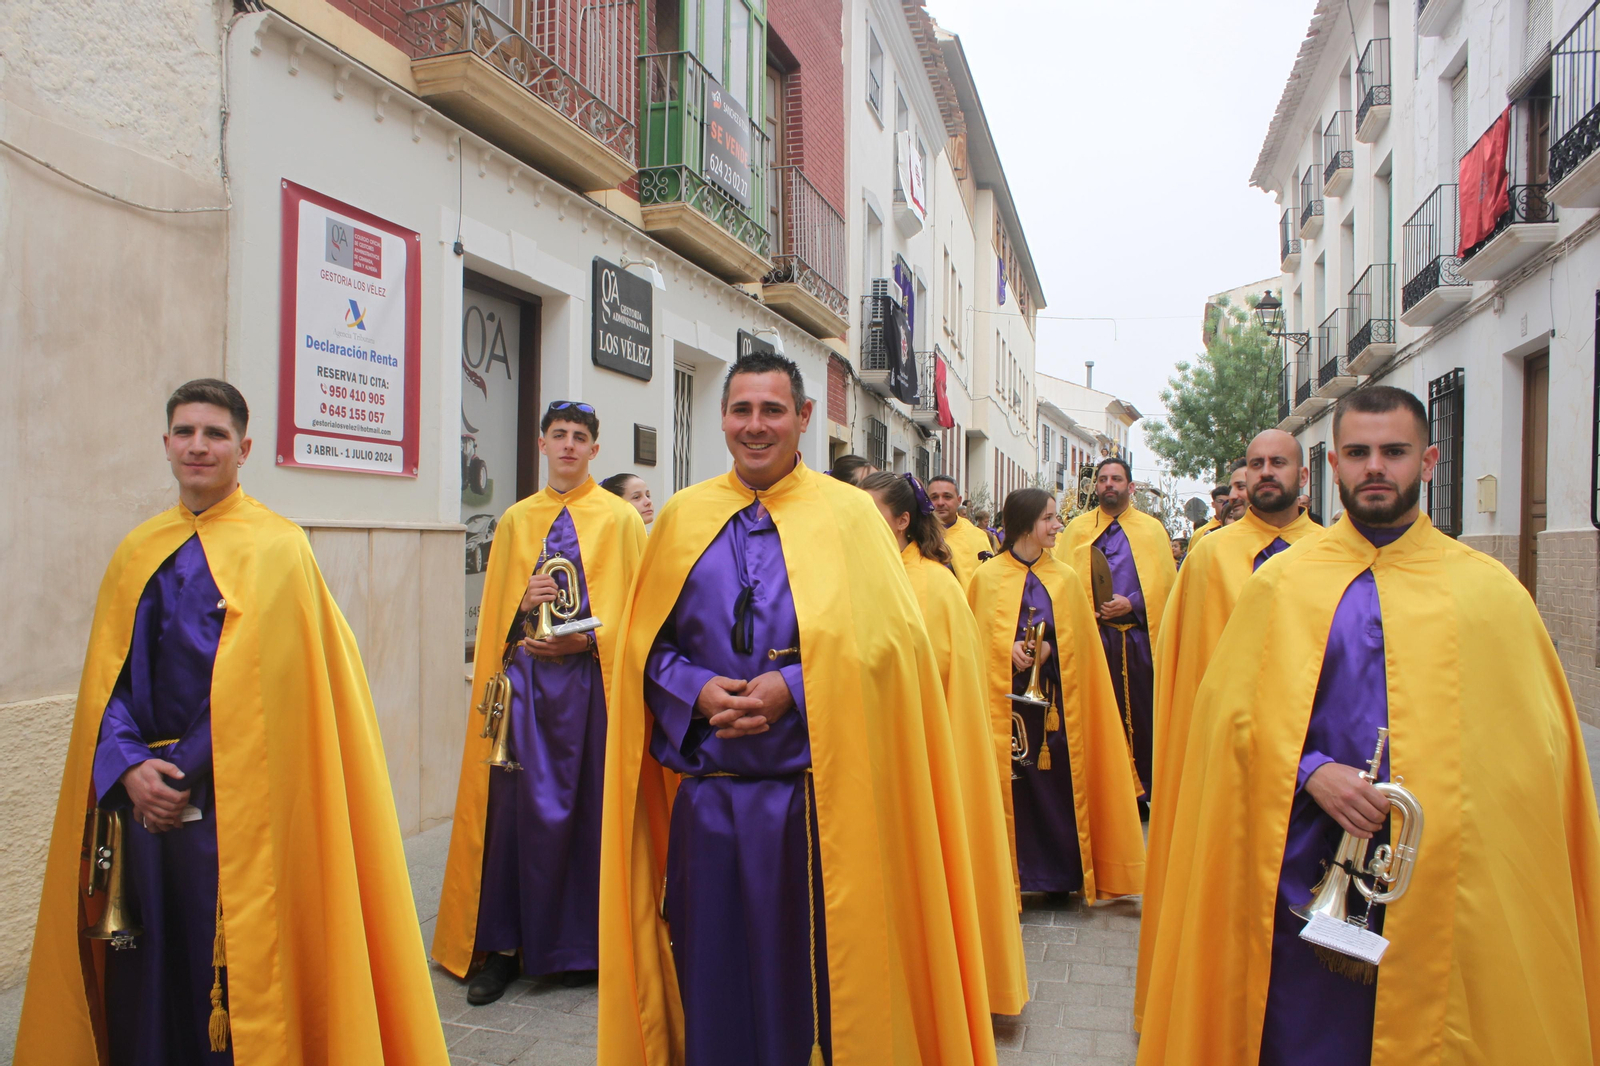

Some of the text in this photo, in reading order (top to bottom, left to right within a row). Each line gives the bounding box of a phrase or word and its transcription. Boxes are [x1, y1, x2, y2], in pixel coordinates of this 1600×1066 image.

[710, 120, 749, 169] SE VENDE
[709, 153, 748, 198] 624 23 02 27
[320, 269, 386, 297] GESTORIA LOS VÉLEZ
[333, 328, 352, 339] Agencia
[612, 312, 650, 335] ADMINISTRATIVA
[306, 334, 398, 367] Declaración Renta
[599, 330, 650, 366] LOS VÉLEZ
[317, 366, 389, 390] RESERVA TU CITA:
[329, 385, 385, 406] 950 410 905
[329, 404, 385, 424] 645 155 057
[312, 419, 391, 436] gestorialosvelez@hotmail.com
[306, 444, 312, 454] 3
[314, 445, 339, 457] ABRIL
[345, 448, 350, 458] 1
[352, 449, 372, 460] JULIO
[375, 452, 392, 462] 2024
